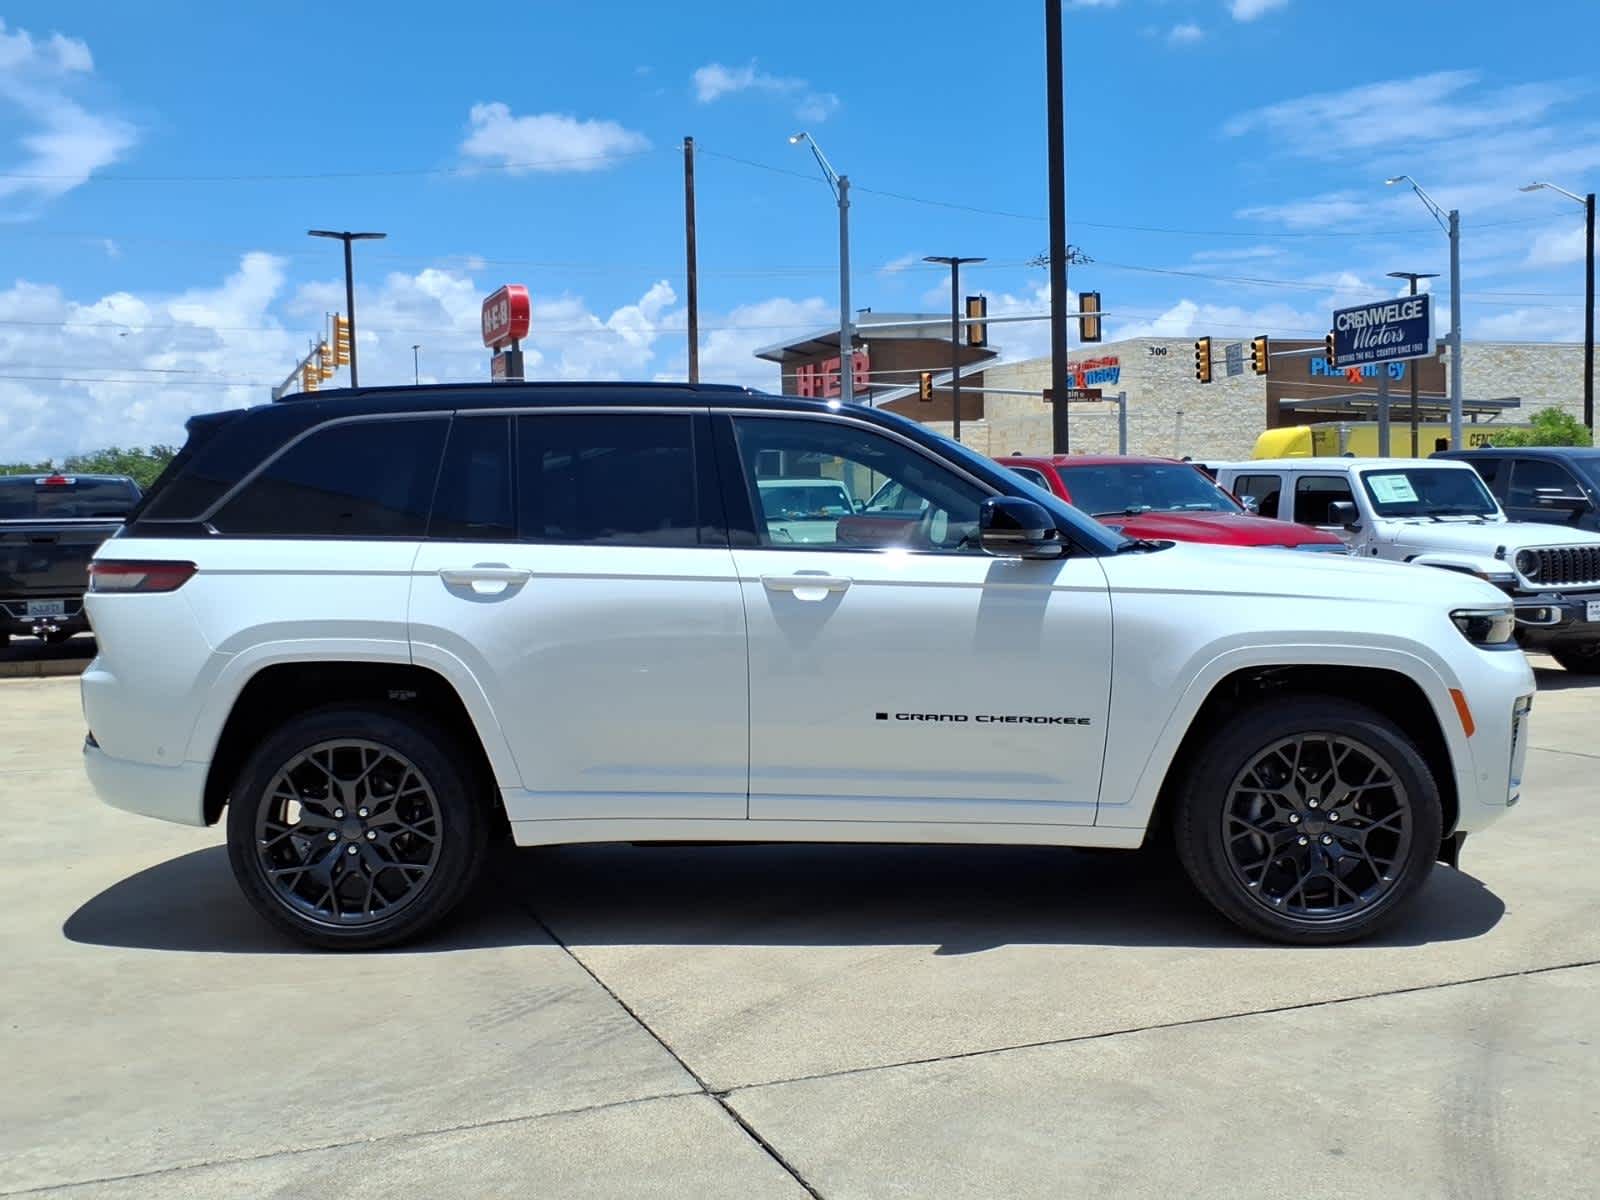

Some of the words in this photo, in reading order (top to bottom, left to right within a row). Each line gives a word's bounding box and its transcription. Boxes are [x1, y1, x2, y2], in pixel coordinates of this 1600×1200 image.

[1337, 300, 1423, 331] CRENWELGE
[1353, 324, 1405, 349] Motors
[1149, 347, 1167, 356] 300
[796, 351, 871, 398] H-EB
[895, 712, 969, 722] GRAND
[975, 714, 1092, 726] CHEROKEE
